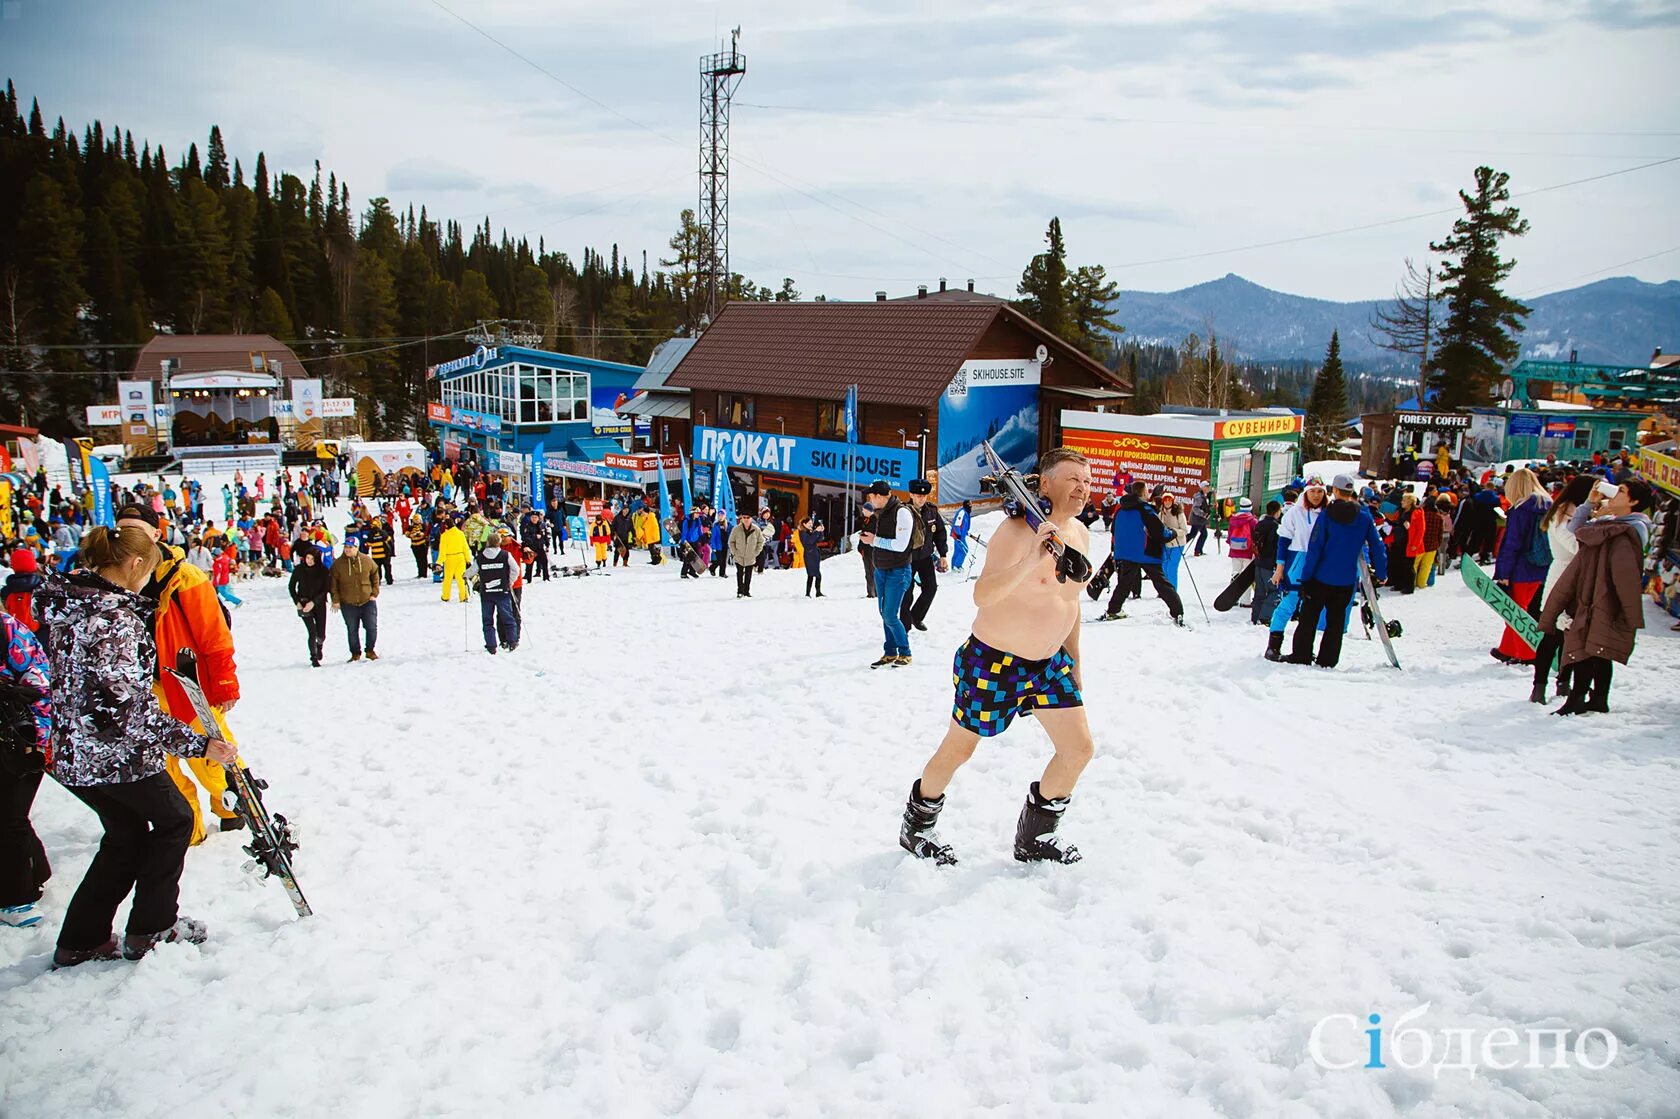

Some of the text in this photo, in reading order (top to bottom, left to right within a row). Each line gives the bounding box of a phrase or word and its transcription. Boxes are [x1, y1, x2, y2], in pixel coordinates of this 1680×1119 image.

[972, 368, 1025, 380] SKIHOUSE.SITE
[1229, 419, 1291, 435] СУВЕНИРЫ
[1399, 414, 1468, 426] FOREST COFFEE
[606, 456, 638, 468] SKI HOUSE
[811, 449, 901, 478] SKI HOUSE
[1090, 447, 1098, 455] ИЗ
[1098, 448, 1115, 457] КЕДРА
[1124, 451, 1175, 463] ПРОИЗВОДИТЕЛЯ,
[1175, 455, 1206, 466] ПОДАРКИ!
[547, 457, 597, 476] СУВЕНИРЫ
[1143, 463, 1167, 473] ДОМИКИ
[1173, 466, 1202, 476] ШКАТУЛКИ
[1092, 467, 1117, 477] МАГНИТЫ
[1153, 473, 1178, 483] ВАРЕНЬЕ
[1162, 481, 1187, 494] РИЛЬЯЖ
